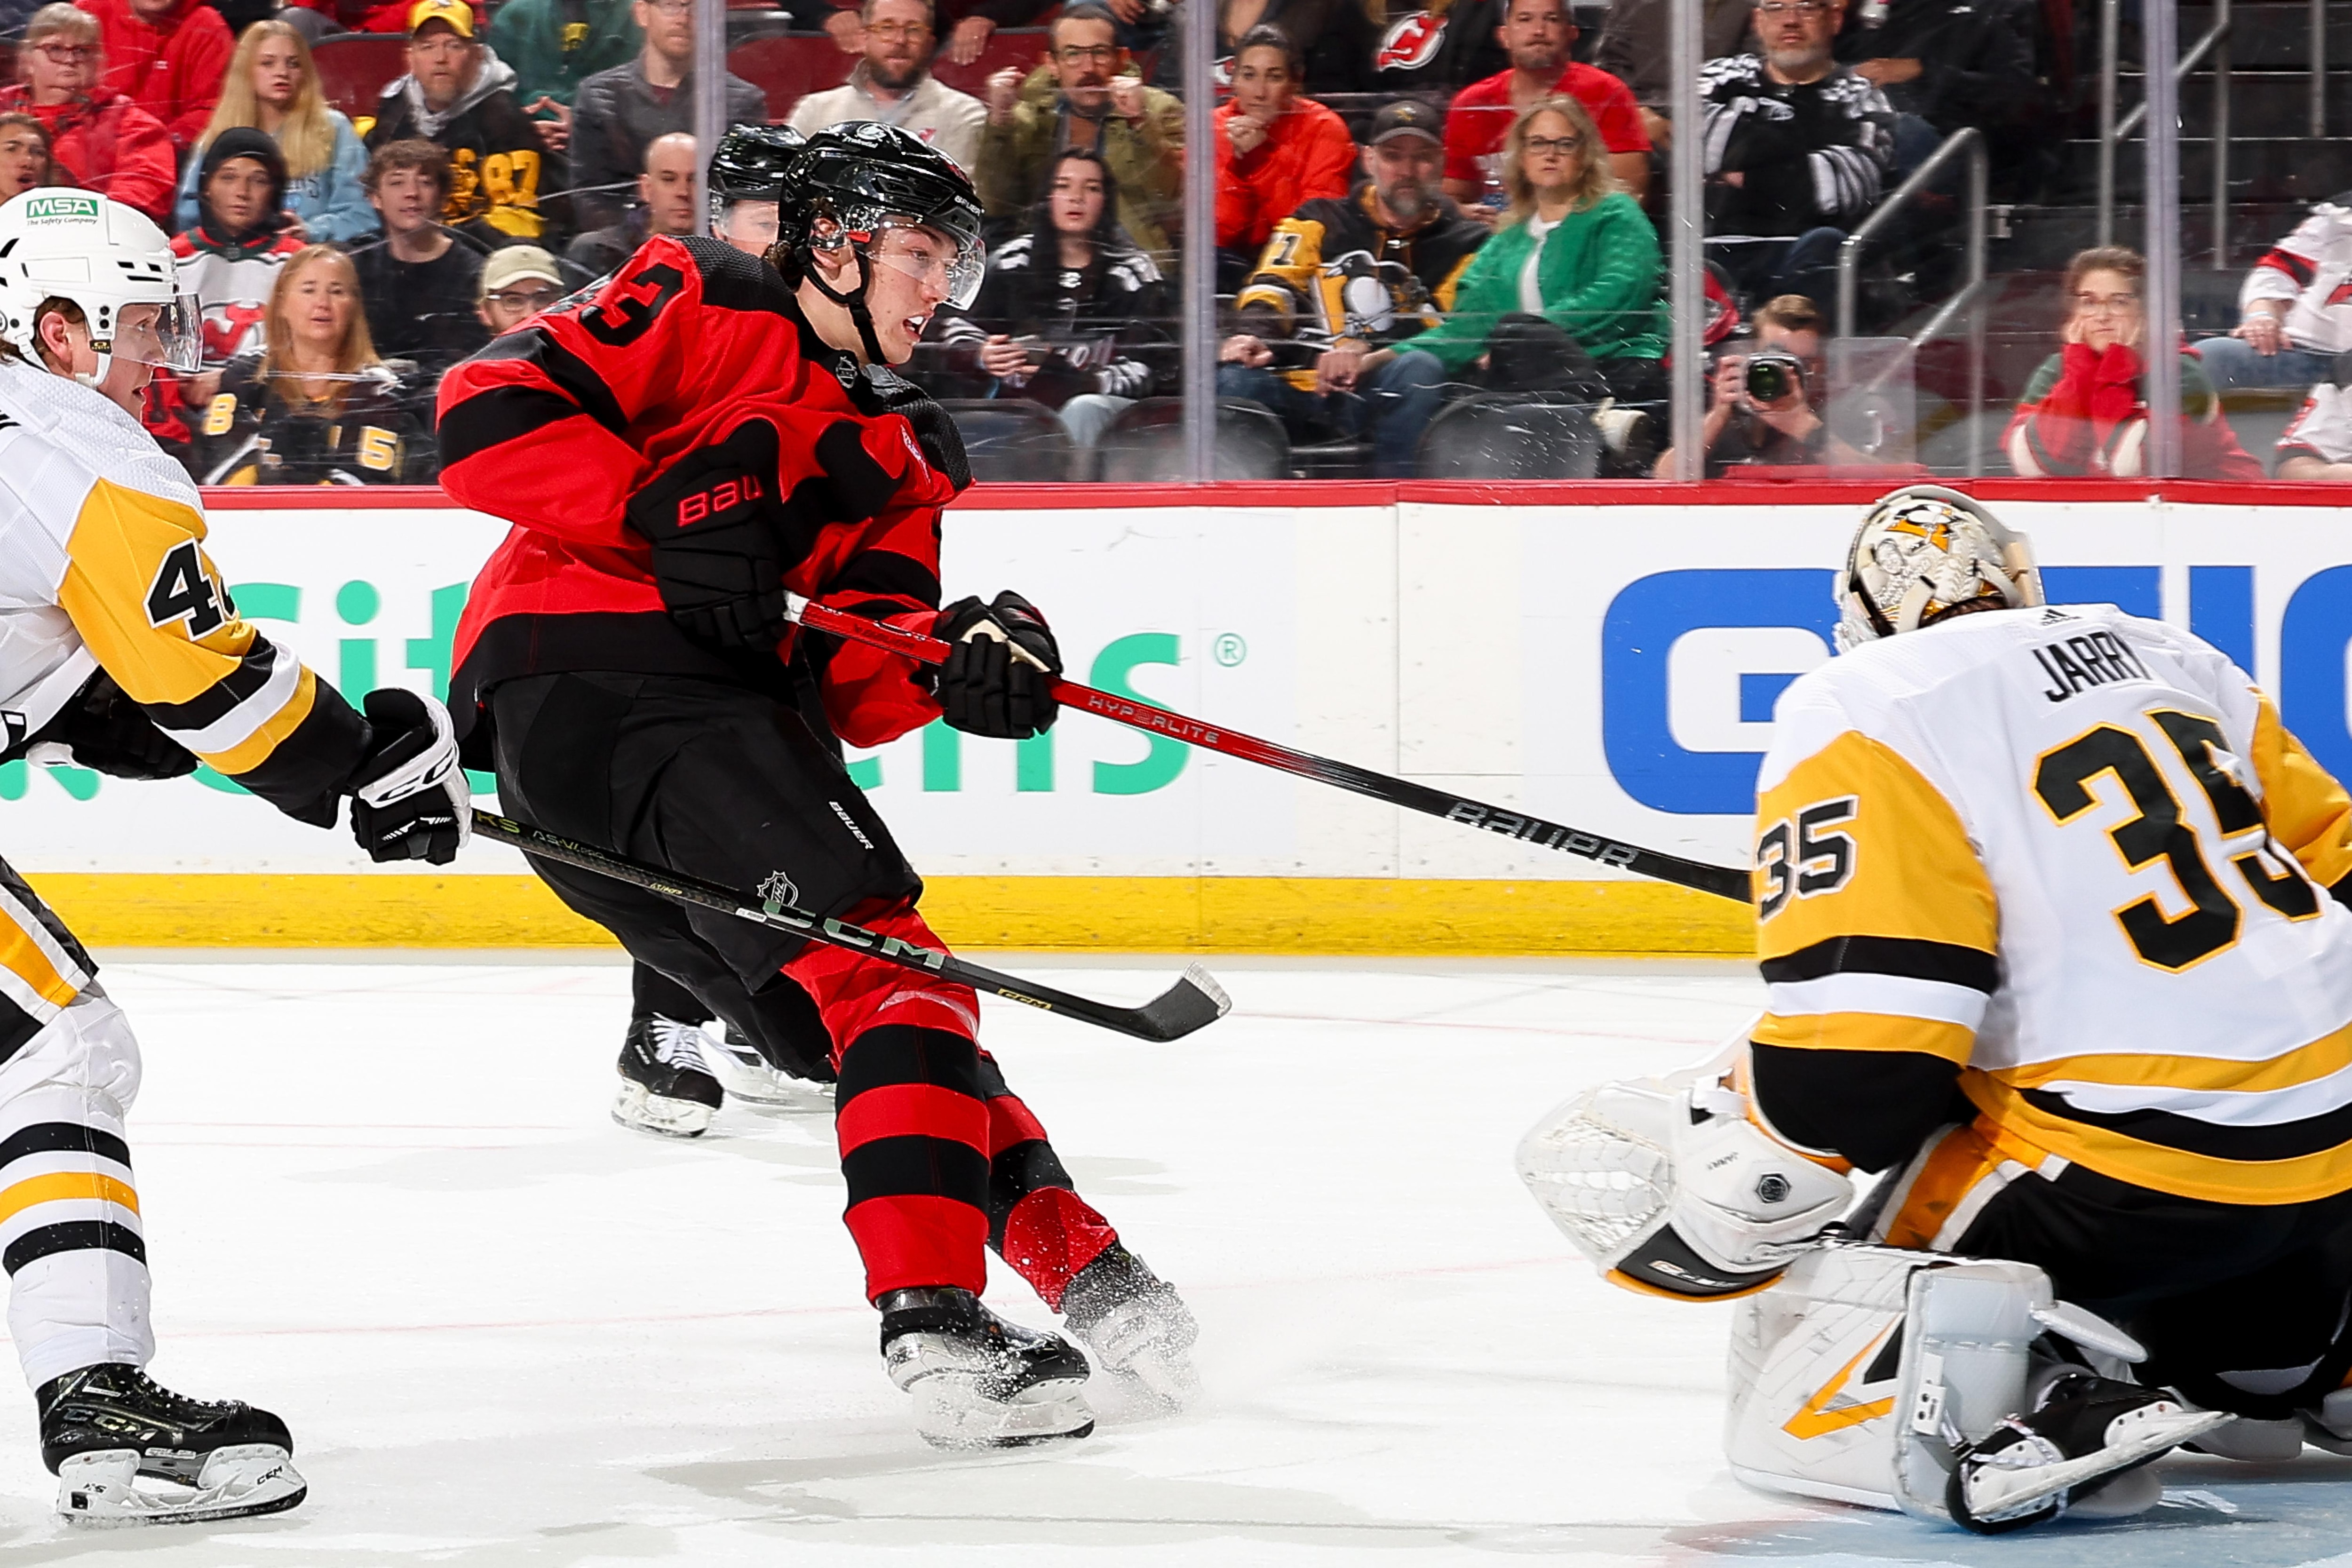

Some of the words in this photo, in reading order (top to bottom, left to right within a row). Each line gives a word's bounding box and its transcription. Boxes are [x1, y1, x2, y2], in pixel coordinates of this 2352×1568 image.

[481, 149, 540, 207] 87
[29, 199, 95, 216] MSA
[41, 217, 62, 226] Safety
[64, 217, 97, 225] Company
[143, 536, 241, 642] 4
[1087, 695, 1220, 744] HYPERLITE
[1756, 794, 1859, 925] 35
[2031, 708, 2325, 974] 35
[763, 899, 946, 971] CCM
[256, 1465, 283, 1485] CCM
